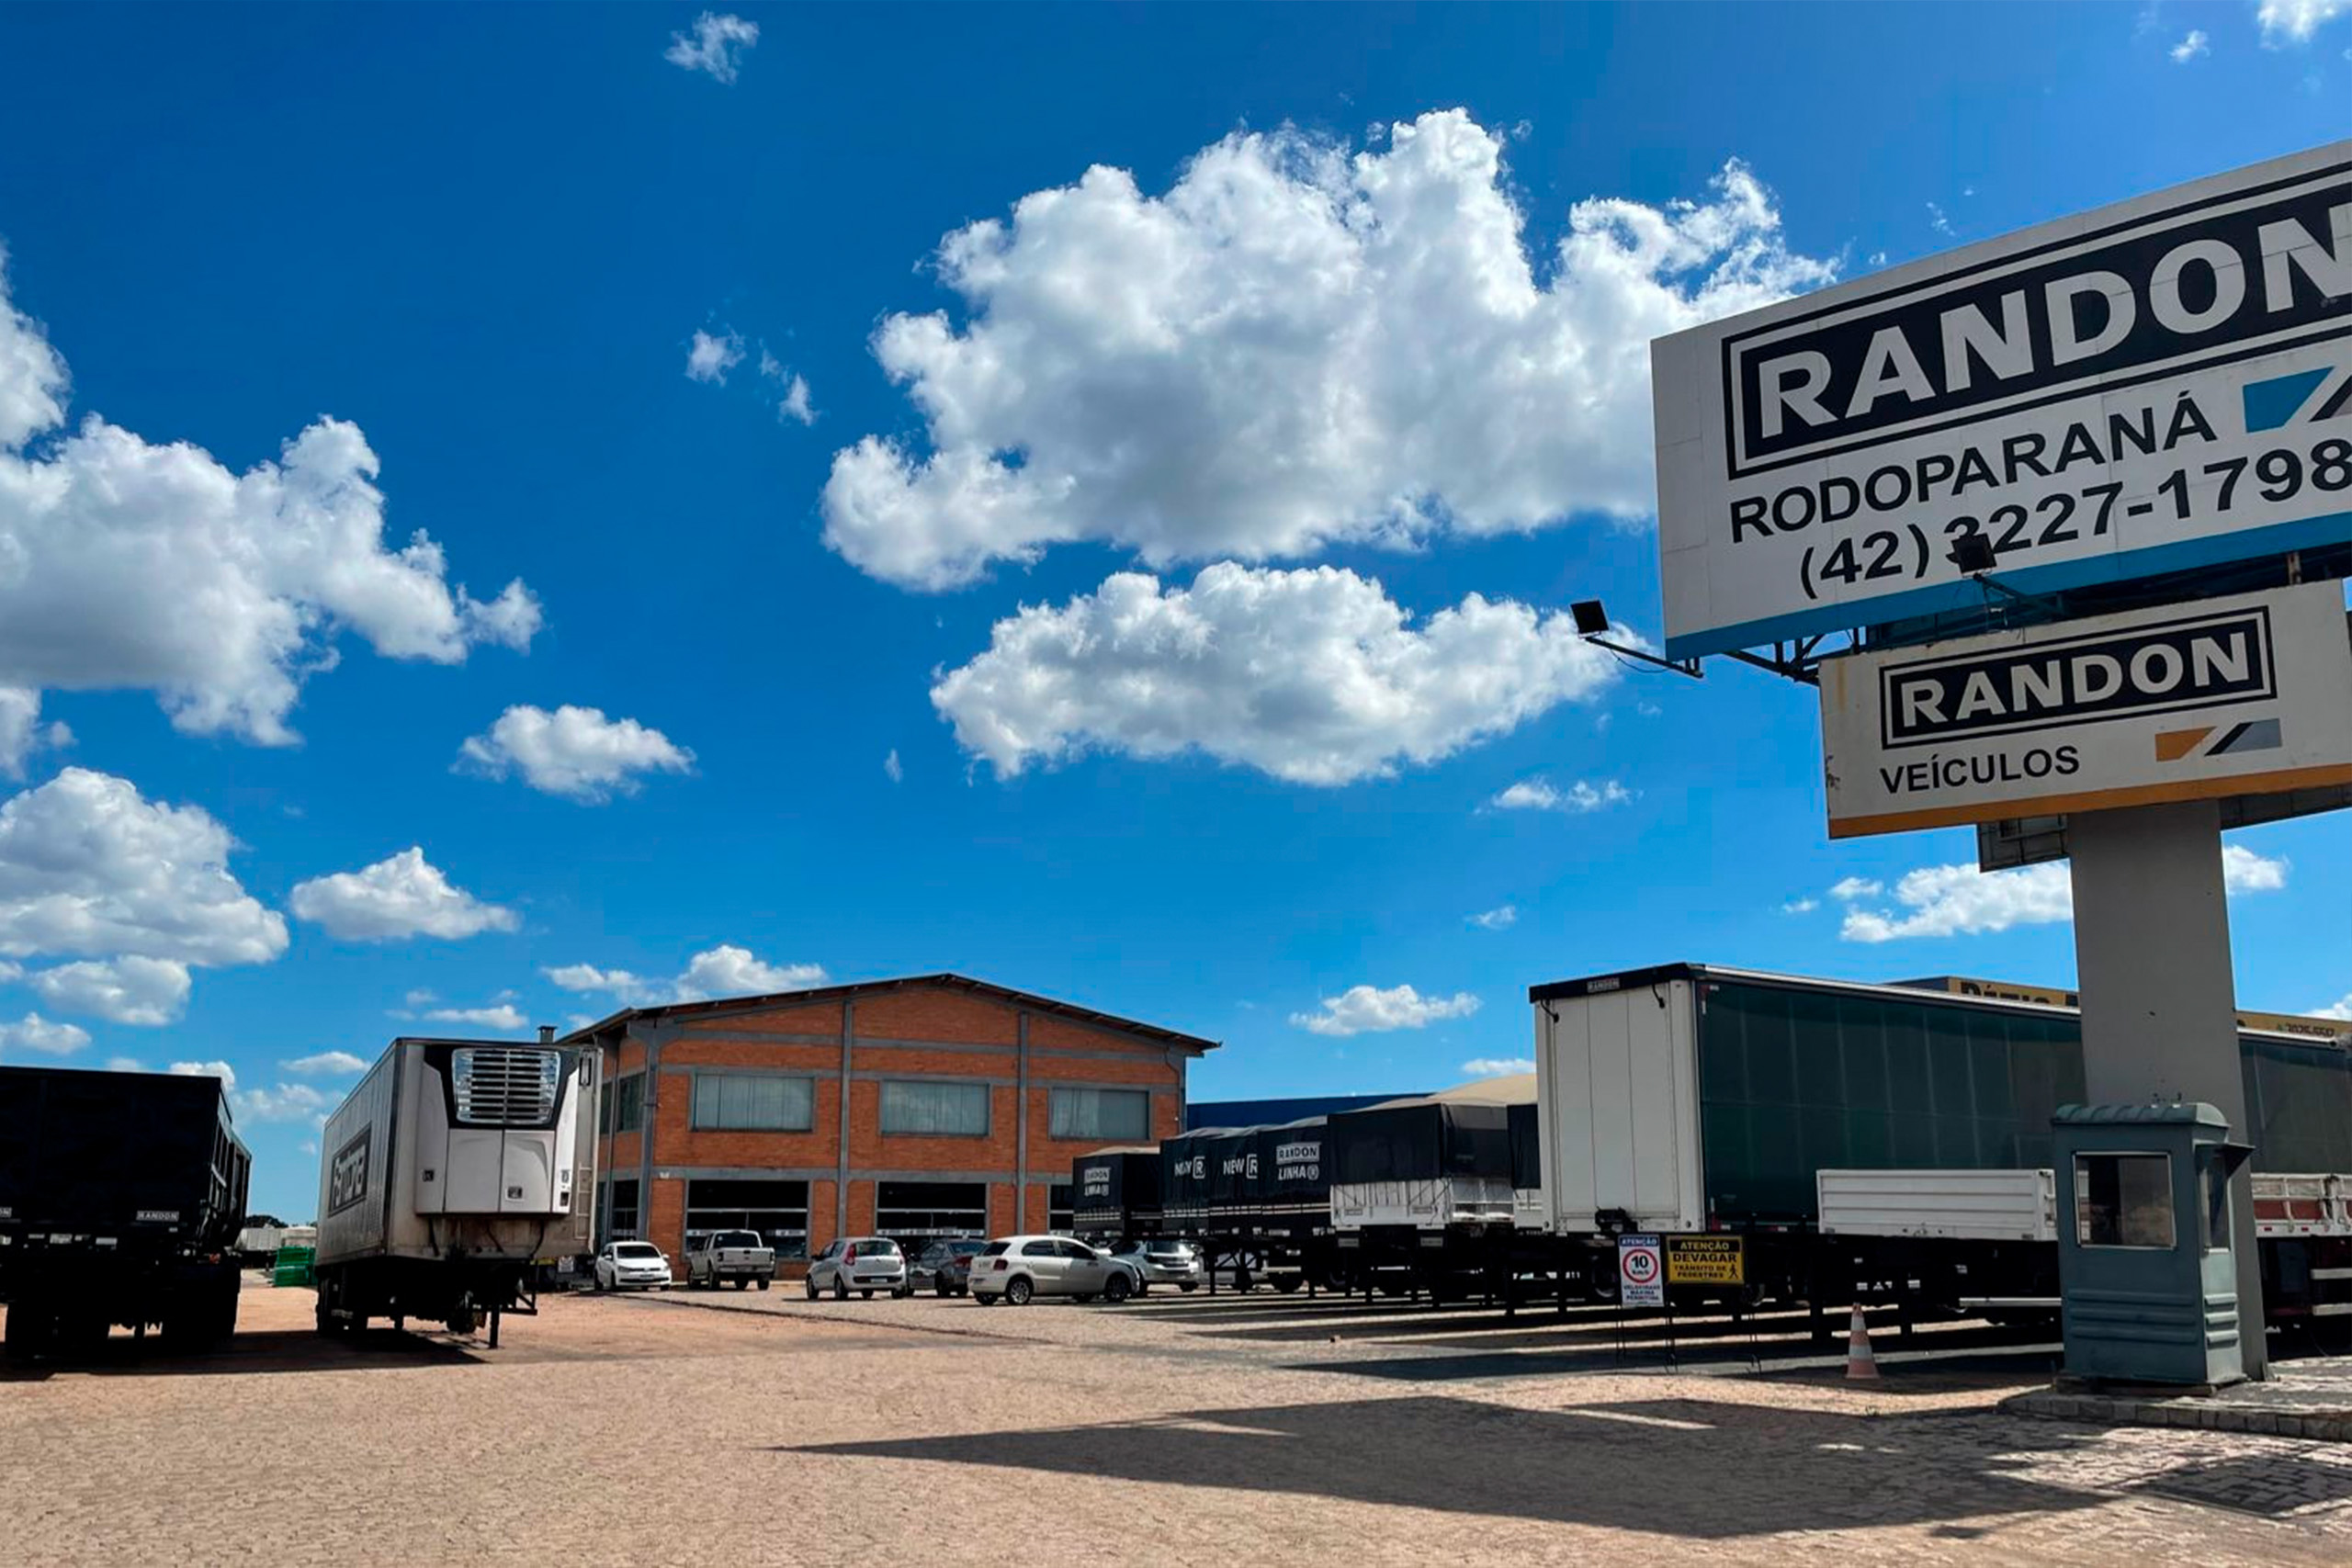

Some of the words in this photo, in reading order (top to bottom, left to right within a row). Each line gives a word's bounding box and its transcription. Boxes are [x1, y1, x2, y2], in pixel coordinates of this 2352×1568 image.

[1758, 205, 2352, 439] RANDON
[1730, 390, 2217, 543] RODOPARANÁ
[1801, 522, 1929, 599] (42)
[1900, 631, 2249, 728] RANDON
[1880, 746, 2079, 795] VEÍCULOS
[1223, 1157, 1245, 1176] NEW
[1622, 1237, 1657, 1246] ATENÇÃO
[1673, 1253, 1737, 1263] DEVAGAR
[1680, 1240, 1730, 1250] ATENÇÃO
[1632, 1255, 1649, 1269] 10
